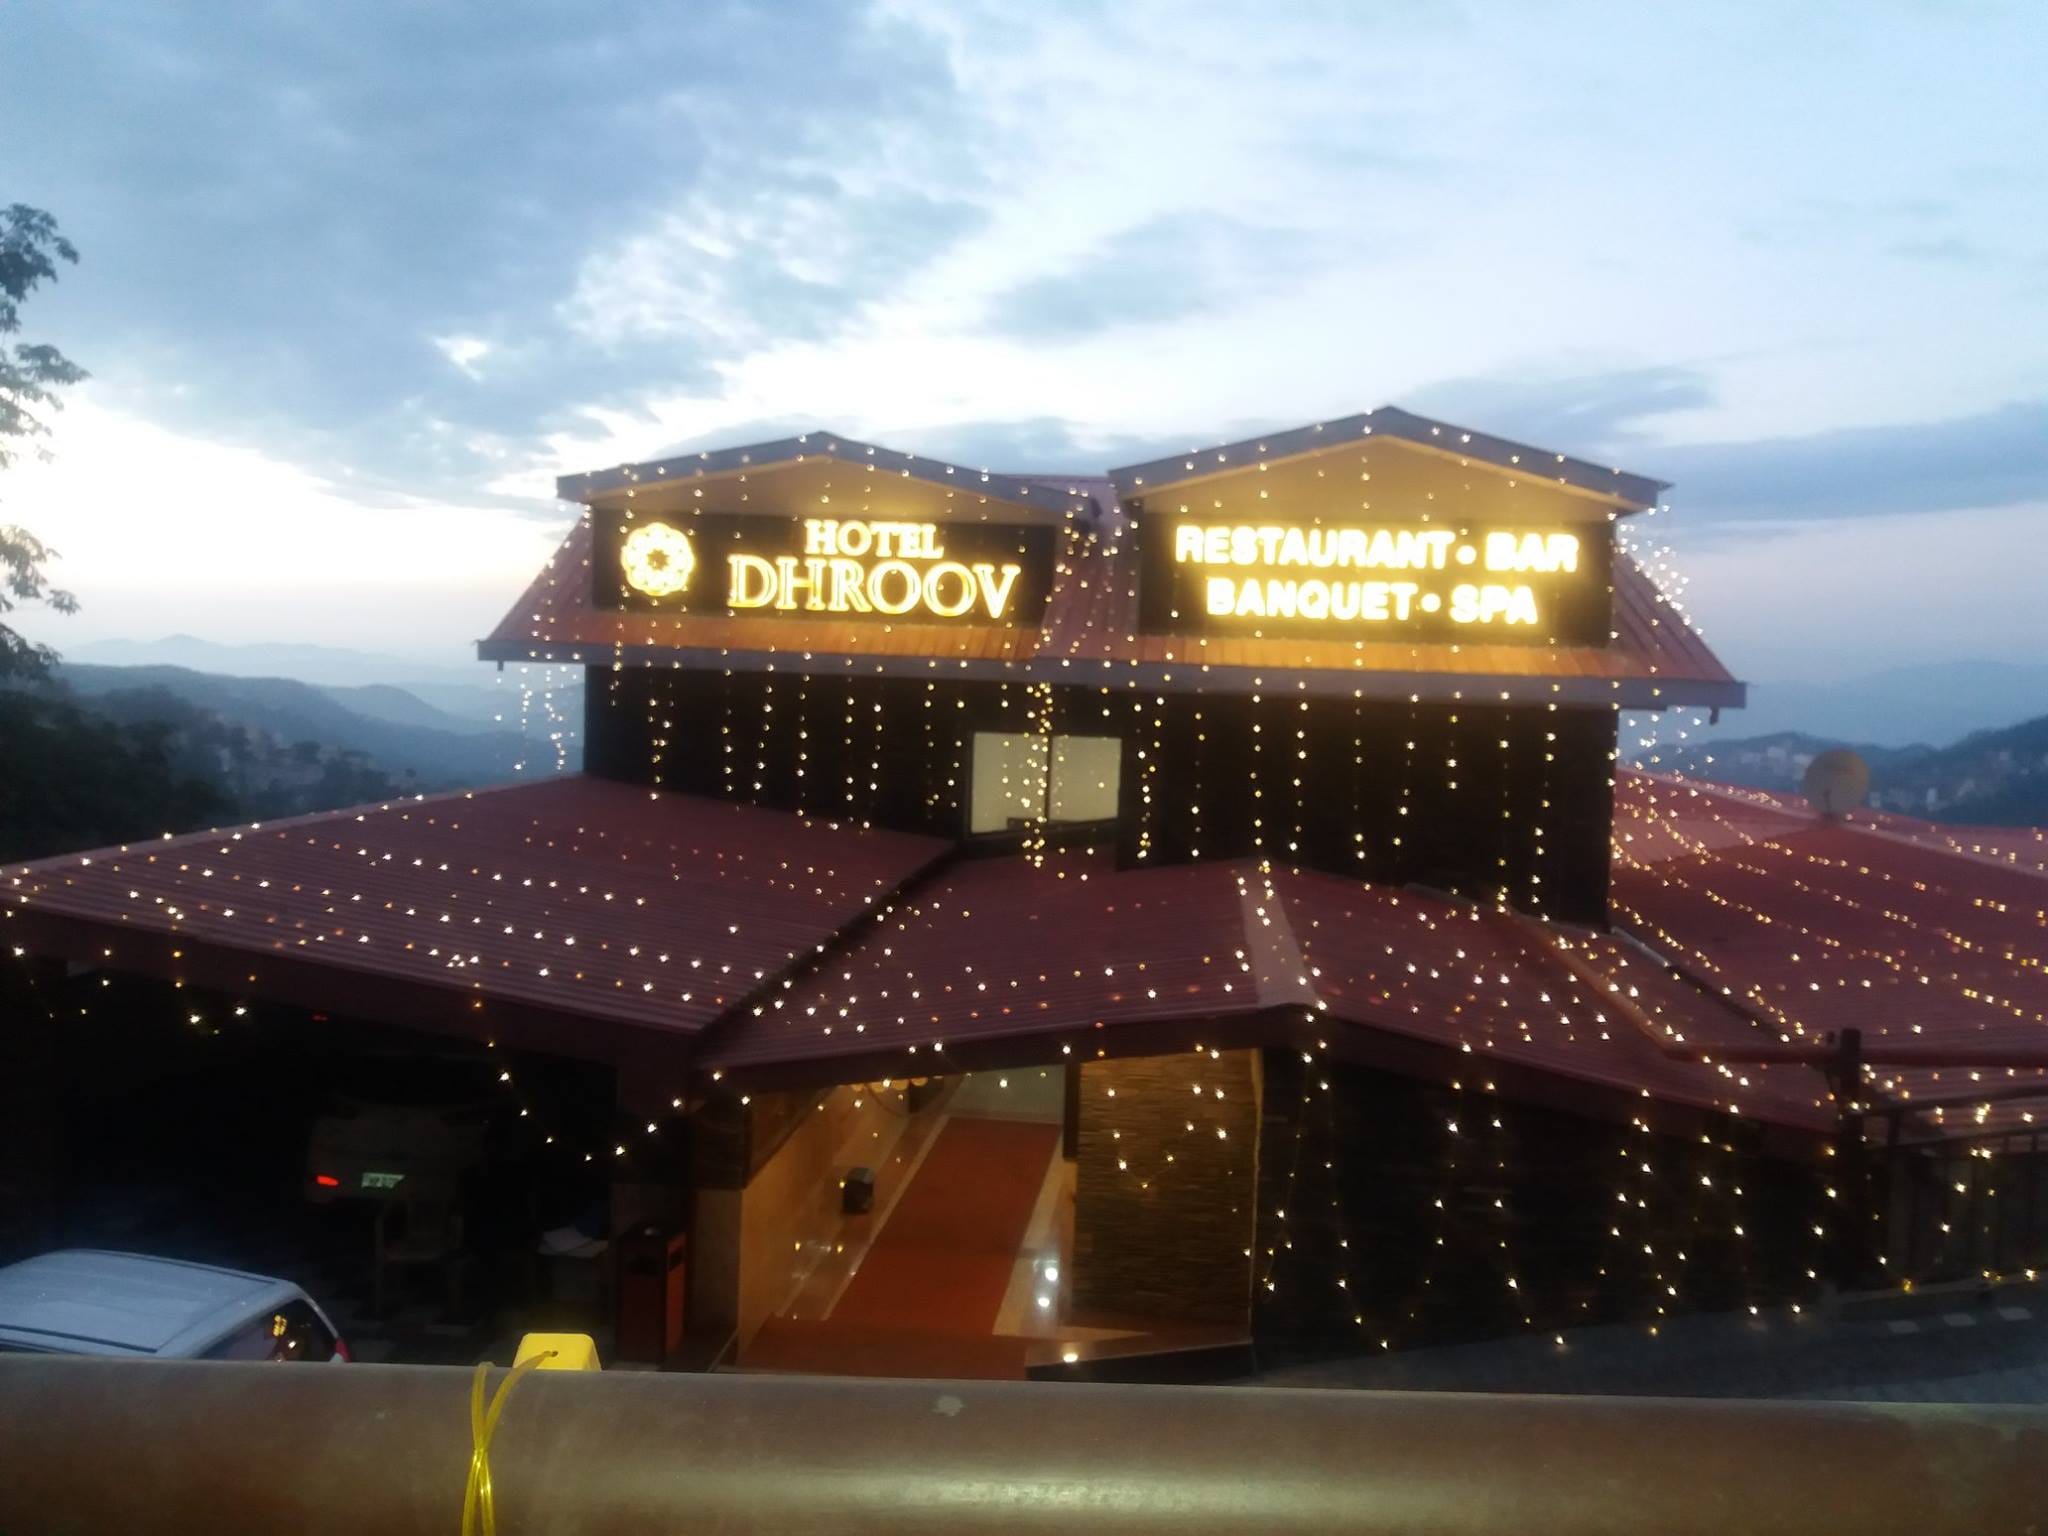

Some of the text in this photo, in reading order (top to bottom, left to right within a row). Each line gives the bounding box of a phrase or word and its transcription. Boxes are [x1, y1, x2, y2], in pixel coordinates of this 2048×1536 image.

[804, 518, 945, 559] HOTEL
[1175, 525, 1580, 573] RESTAURANT BAR
[727, 554, 1021, 619] DHROOV
[1205, 577, 1539, 625] BANQUET SPA
